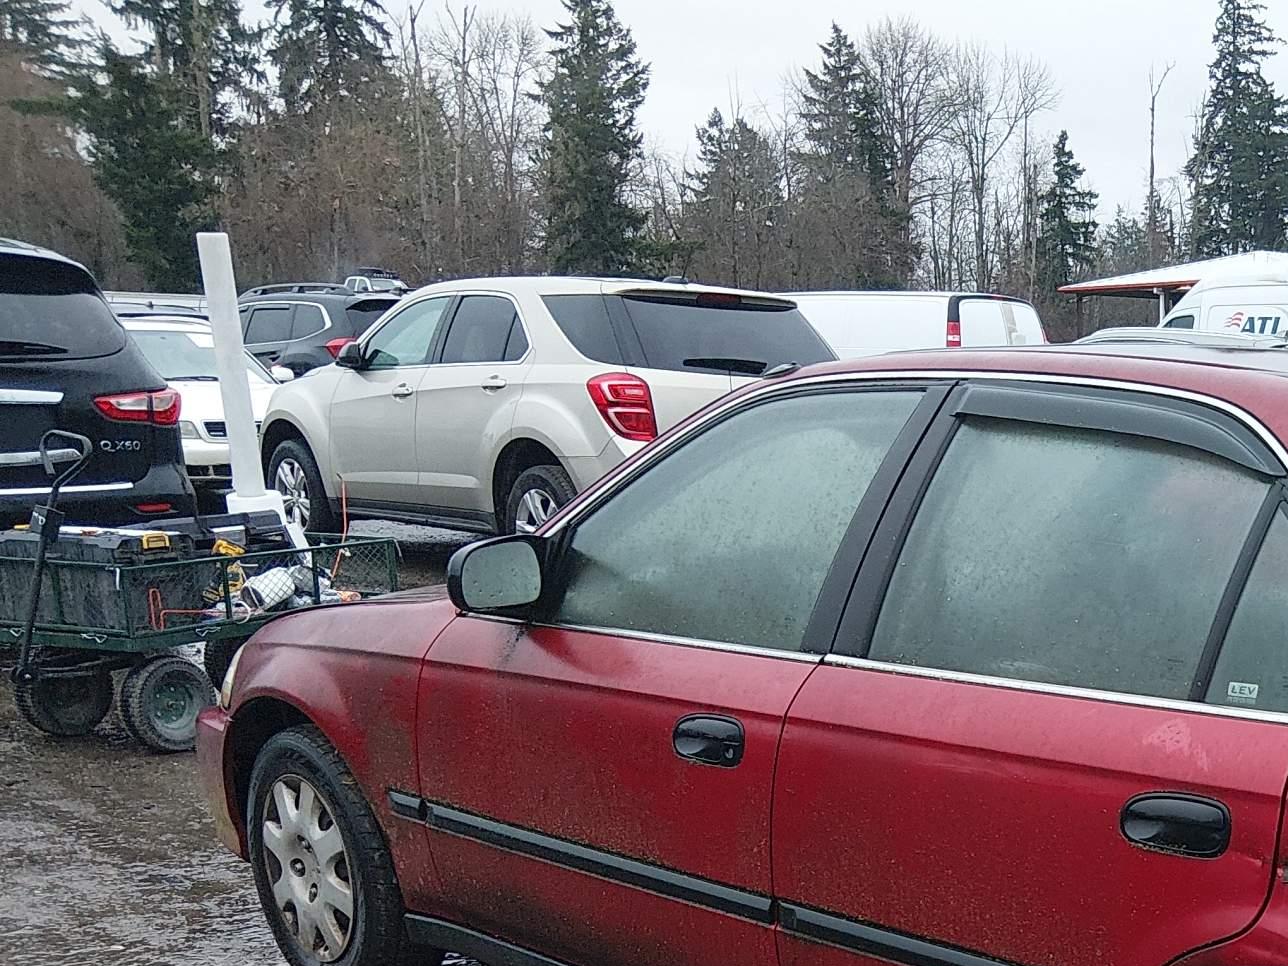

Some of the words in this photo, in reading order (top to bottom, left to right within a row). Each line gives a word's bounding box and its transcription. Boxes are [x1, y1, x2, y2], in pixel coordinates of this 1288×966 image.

[1240, 316, 1281, 335] ATI
[100, 440, 141, 452] QX60
[1231, 685, 1257, 696] LEV
